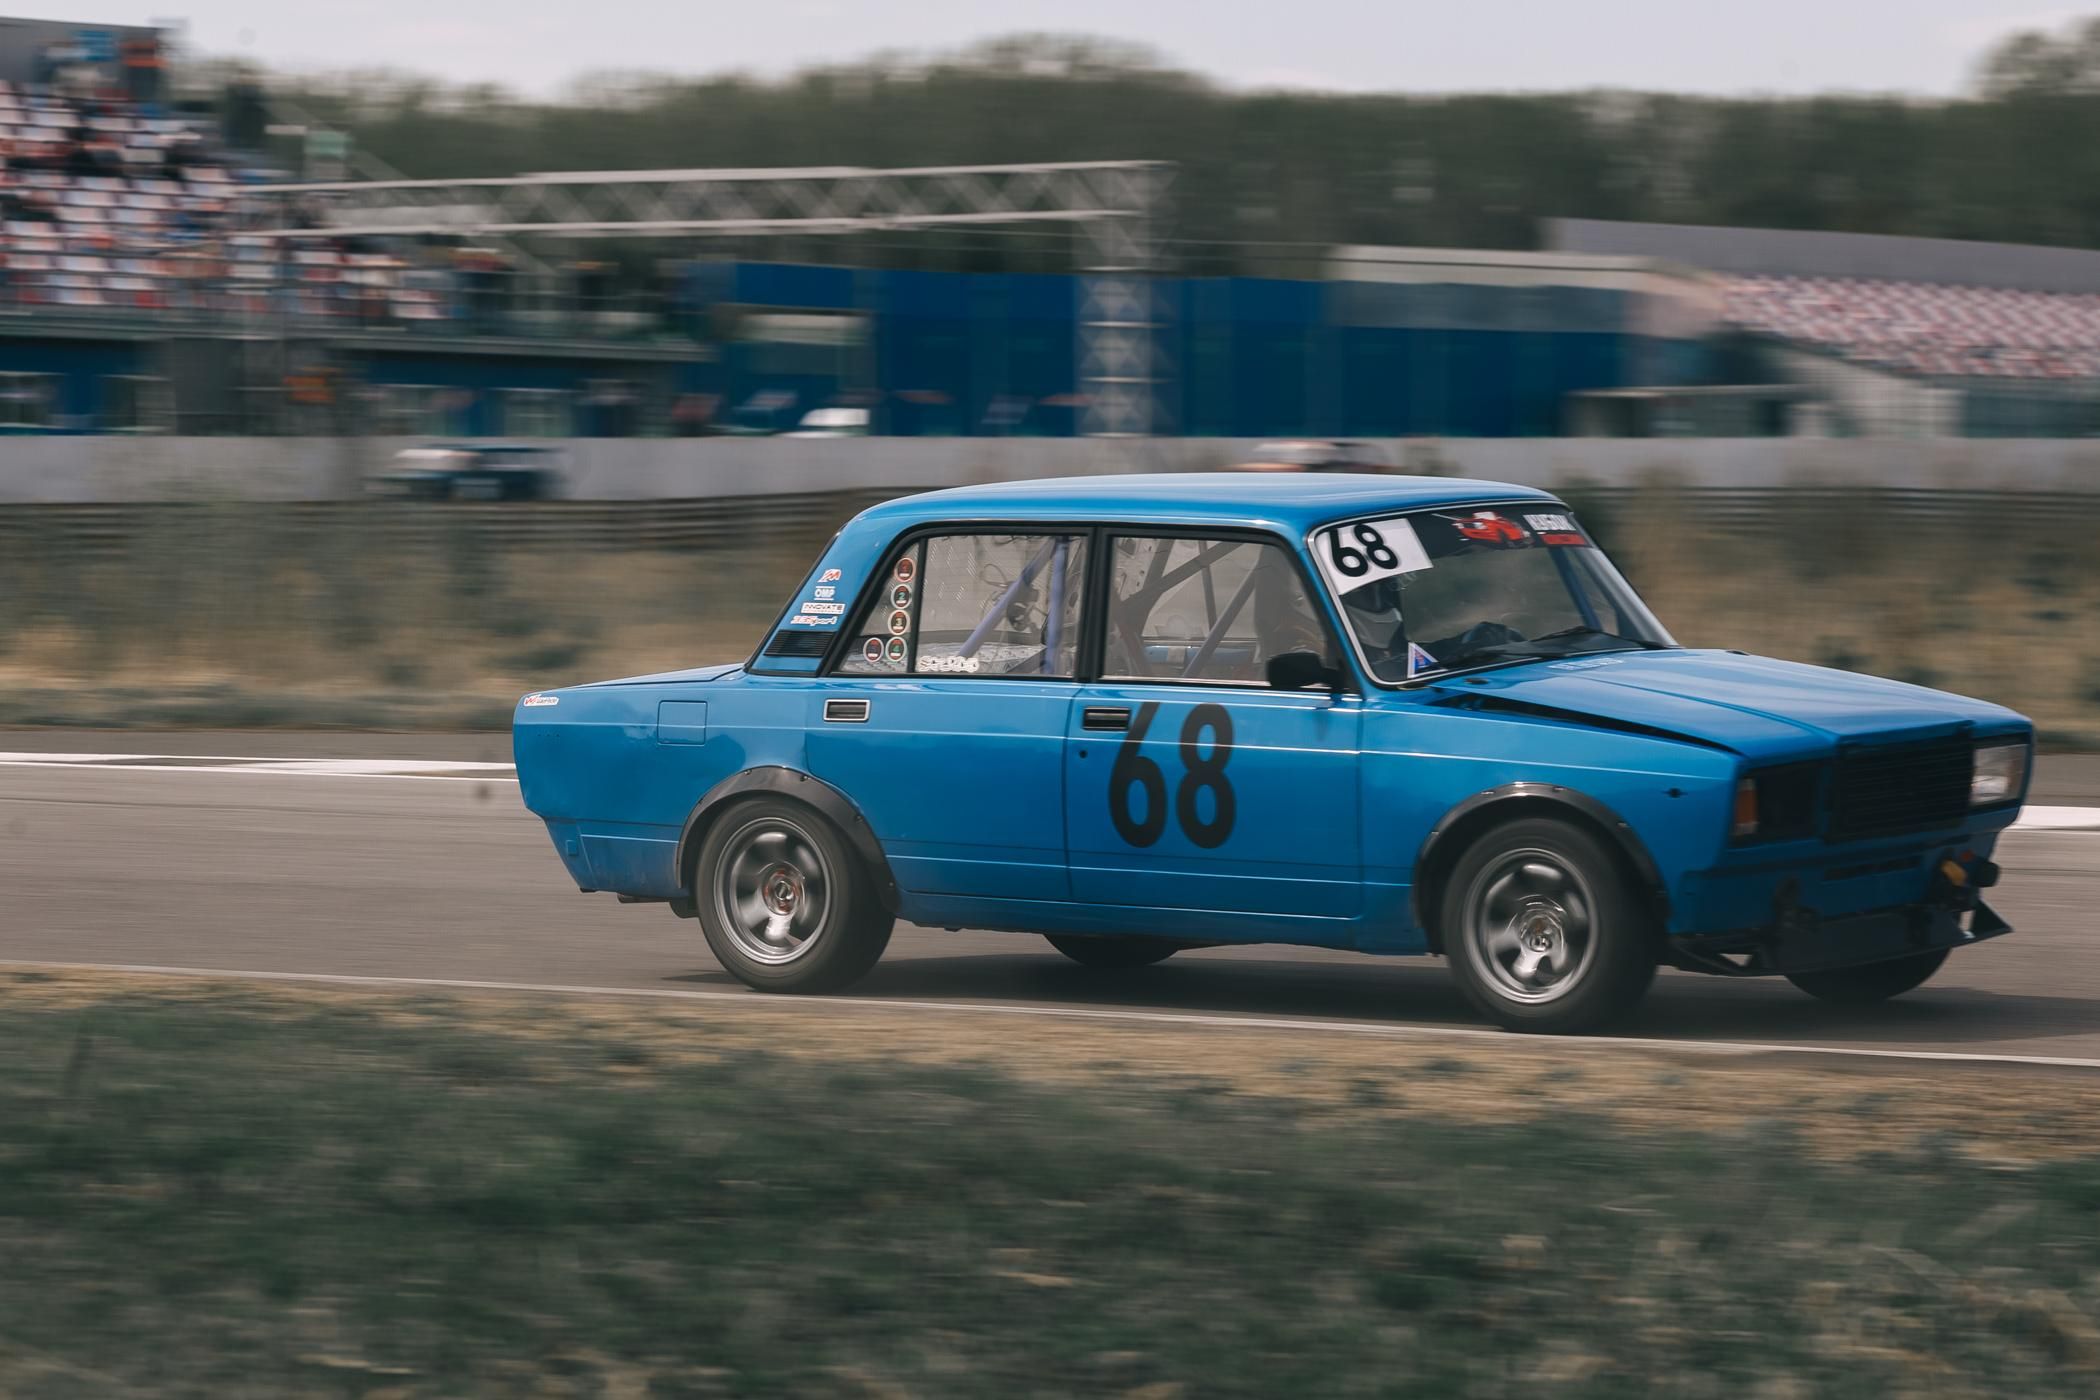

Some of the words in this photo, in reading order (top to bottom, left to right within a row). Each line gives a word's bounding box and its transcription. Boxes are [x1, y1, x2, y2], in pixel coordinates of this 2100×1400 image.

[1329, 524, 1398, 577] 68
[815, 588, 835, 598] OMP
[1109, 702, 1236, 849] 68
